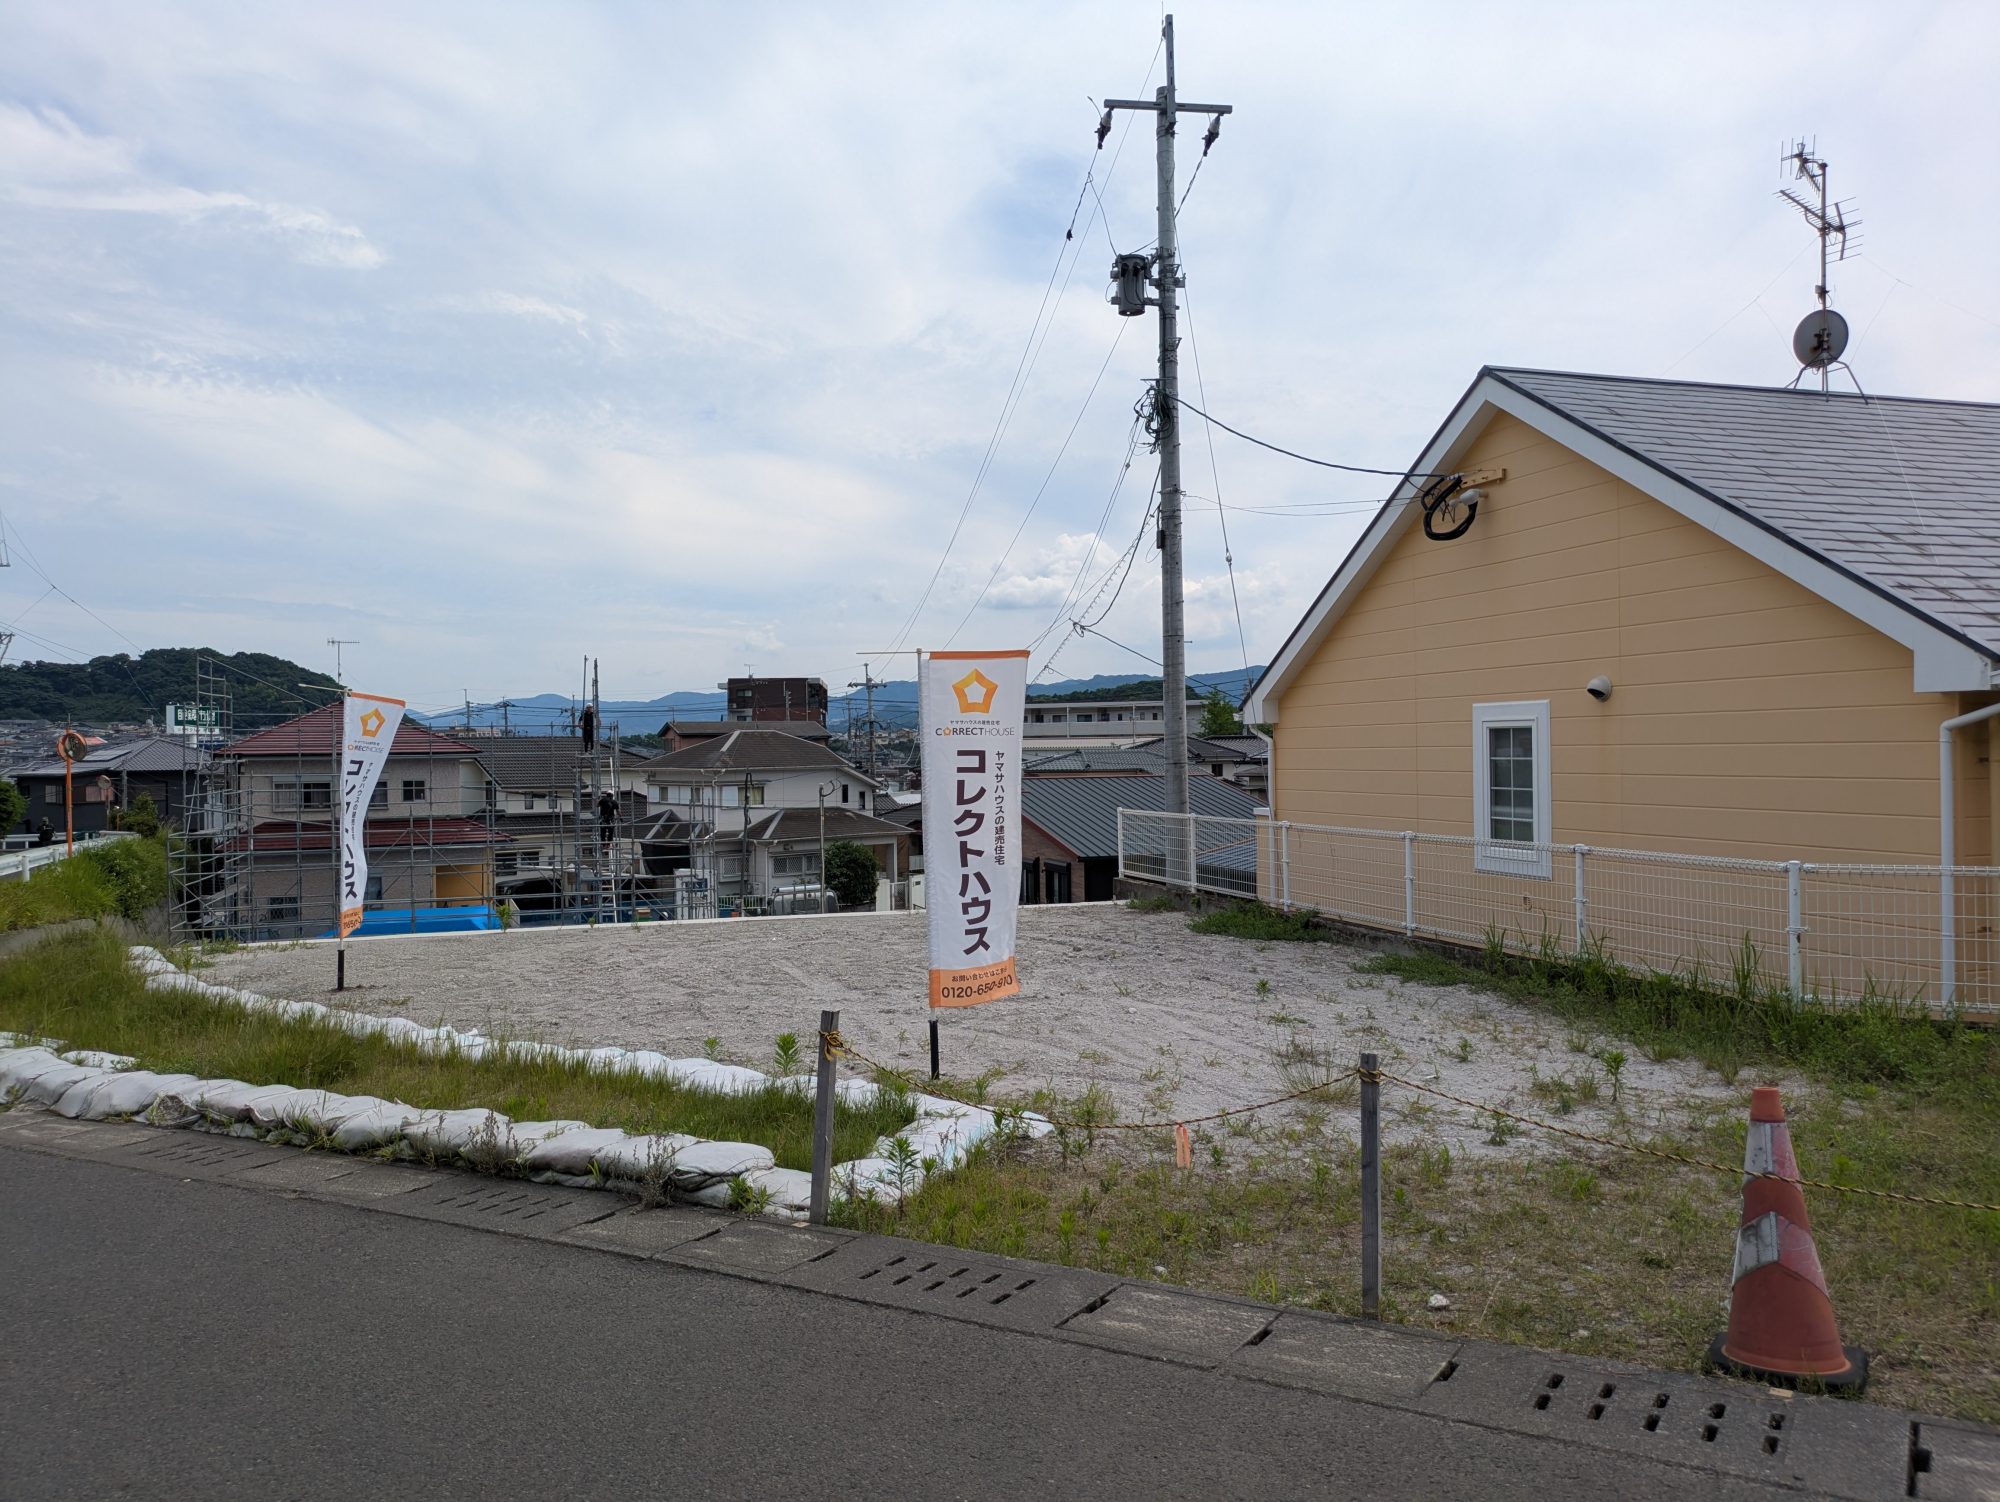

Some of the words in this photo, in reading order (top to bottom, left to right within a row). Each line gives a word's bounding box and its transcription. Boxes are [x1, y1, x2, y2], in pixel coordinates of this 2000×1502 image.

[953, 750, 992, 956] コレクトハウス
[994, 750, 1006, 866] ヤマサハウスの建売住宅
